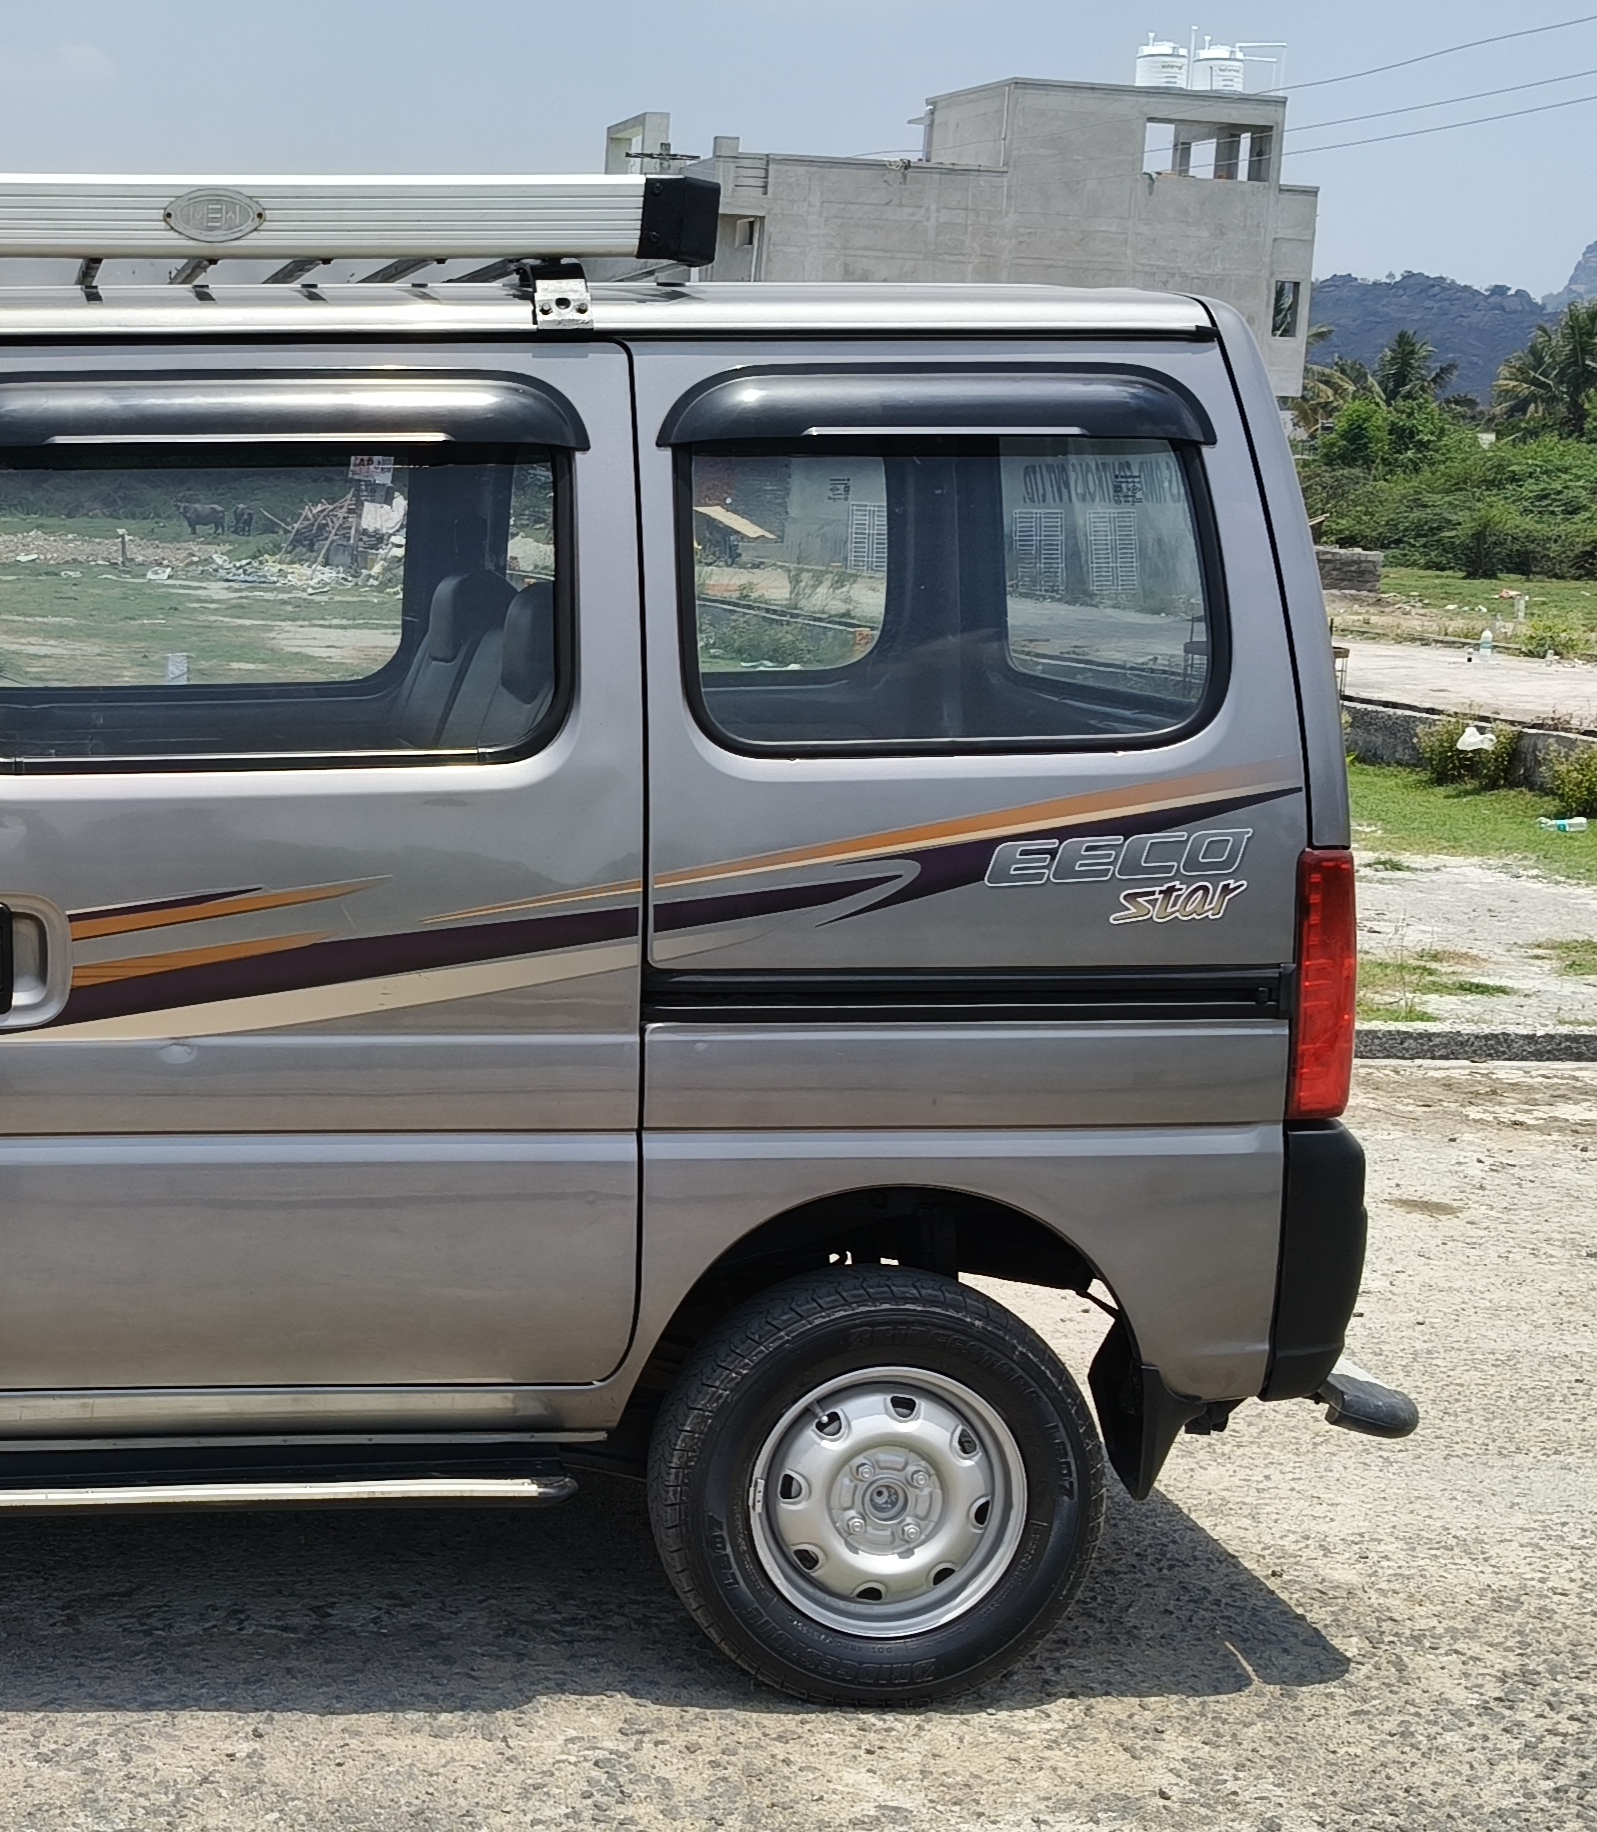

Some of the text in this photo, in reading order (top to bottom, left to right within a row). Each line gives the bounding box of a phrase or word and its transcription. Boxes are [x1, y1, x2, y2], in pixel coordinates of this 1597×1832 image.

[984, 828, 1253, 887] EECO
[1109, 879, 1247, 925] star
[742, 1604, 941, 1684] BRIDGESTONE
